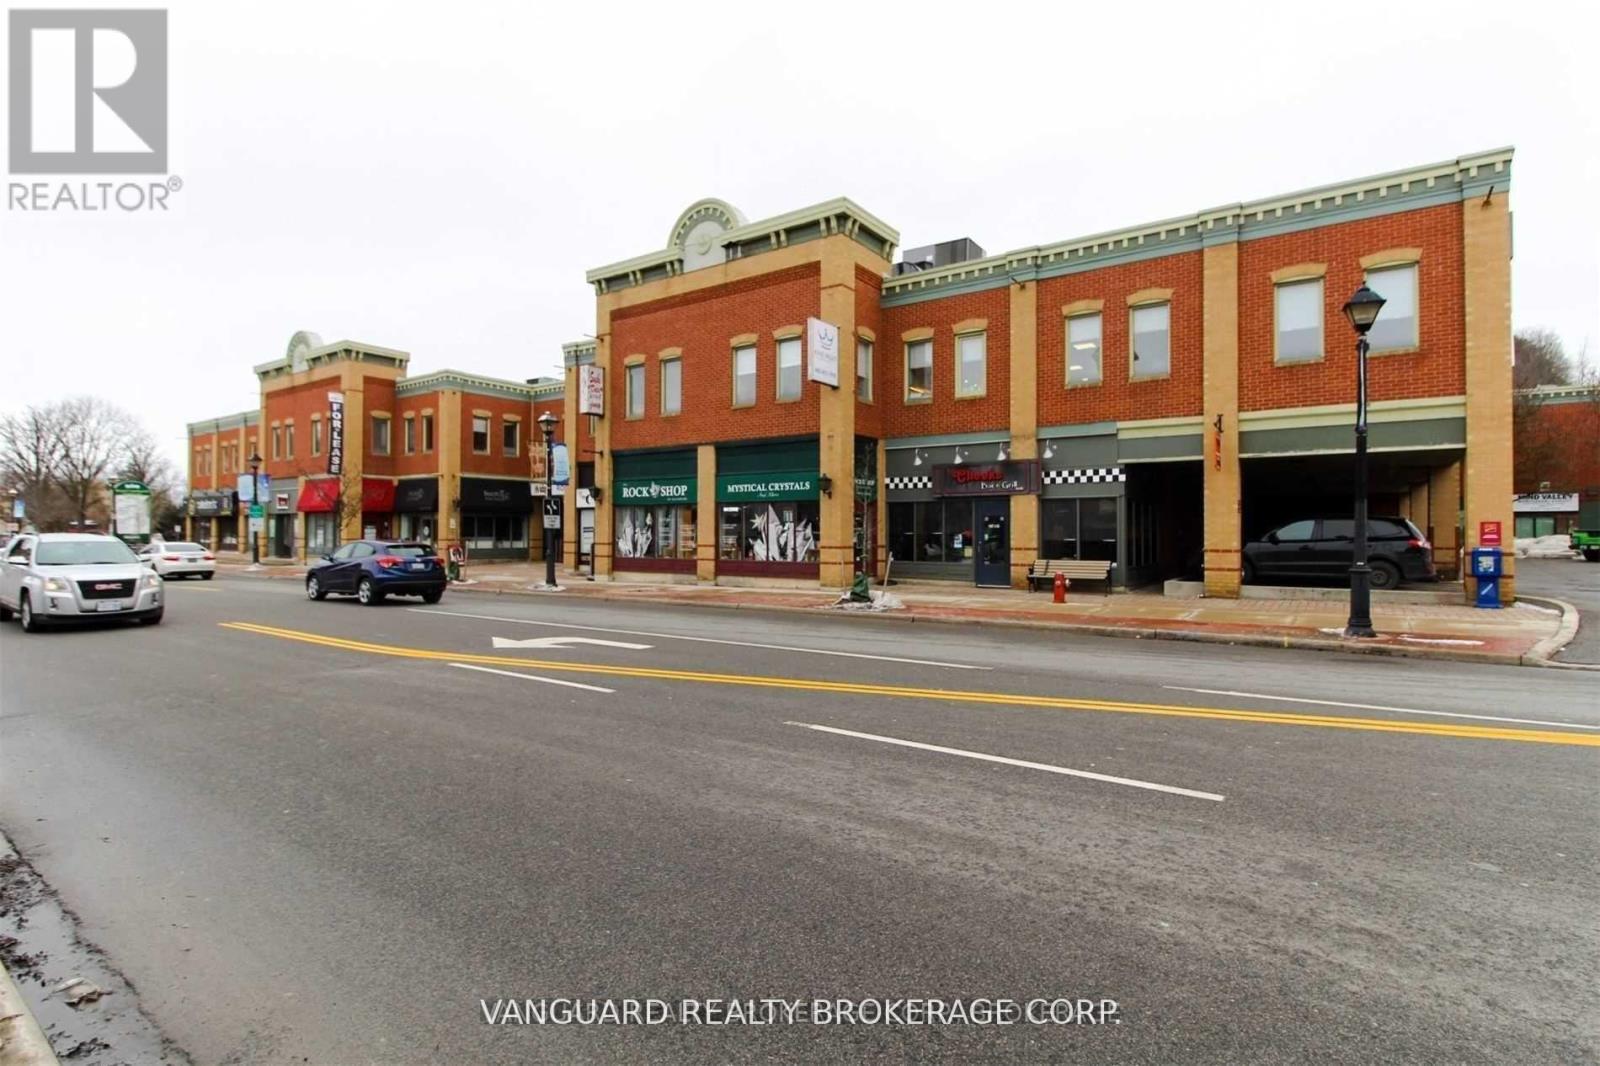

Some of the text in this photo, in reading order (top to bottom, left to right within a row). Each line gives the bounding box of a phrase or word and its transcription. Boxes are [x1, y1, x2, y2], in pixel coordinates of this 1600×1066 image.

[331, 430, 342, 474] LEASE
[622, 485, 688, 498] ROCK SHOP
[727, 481, 810, 492] MYSTICAL CRYSTALS
